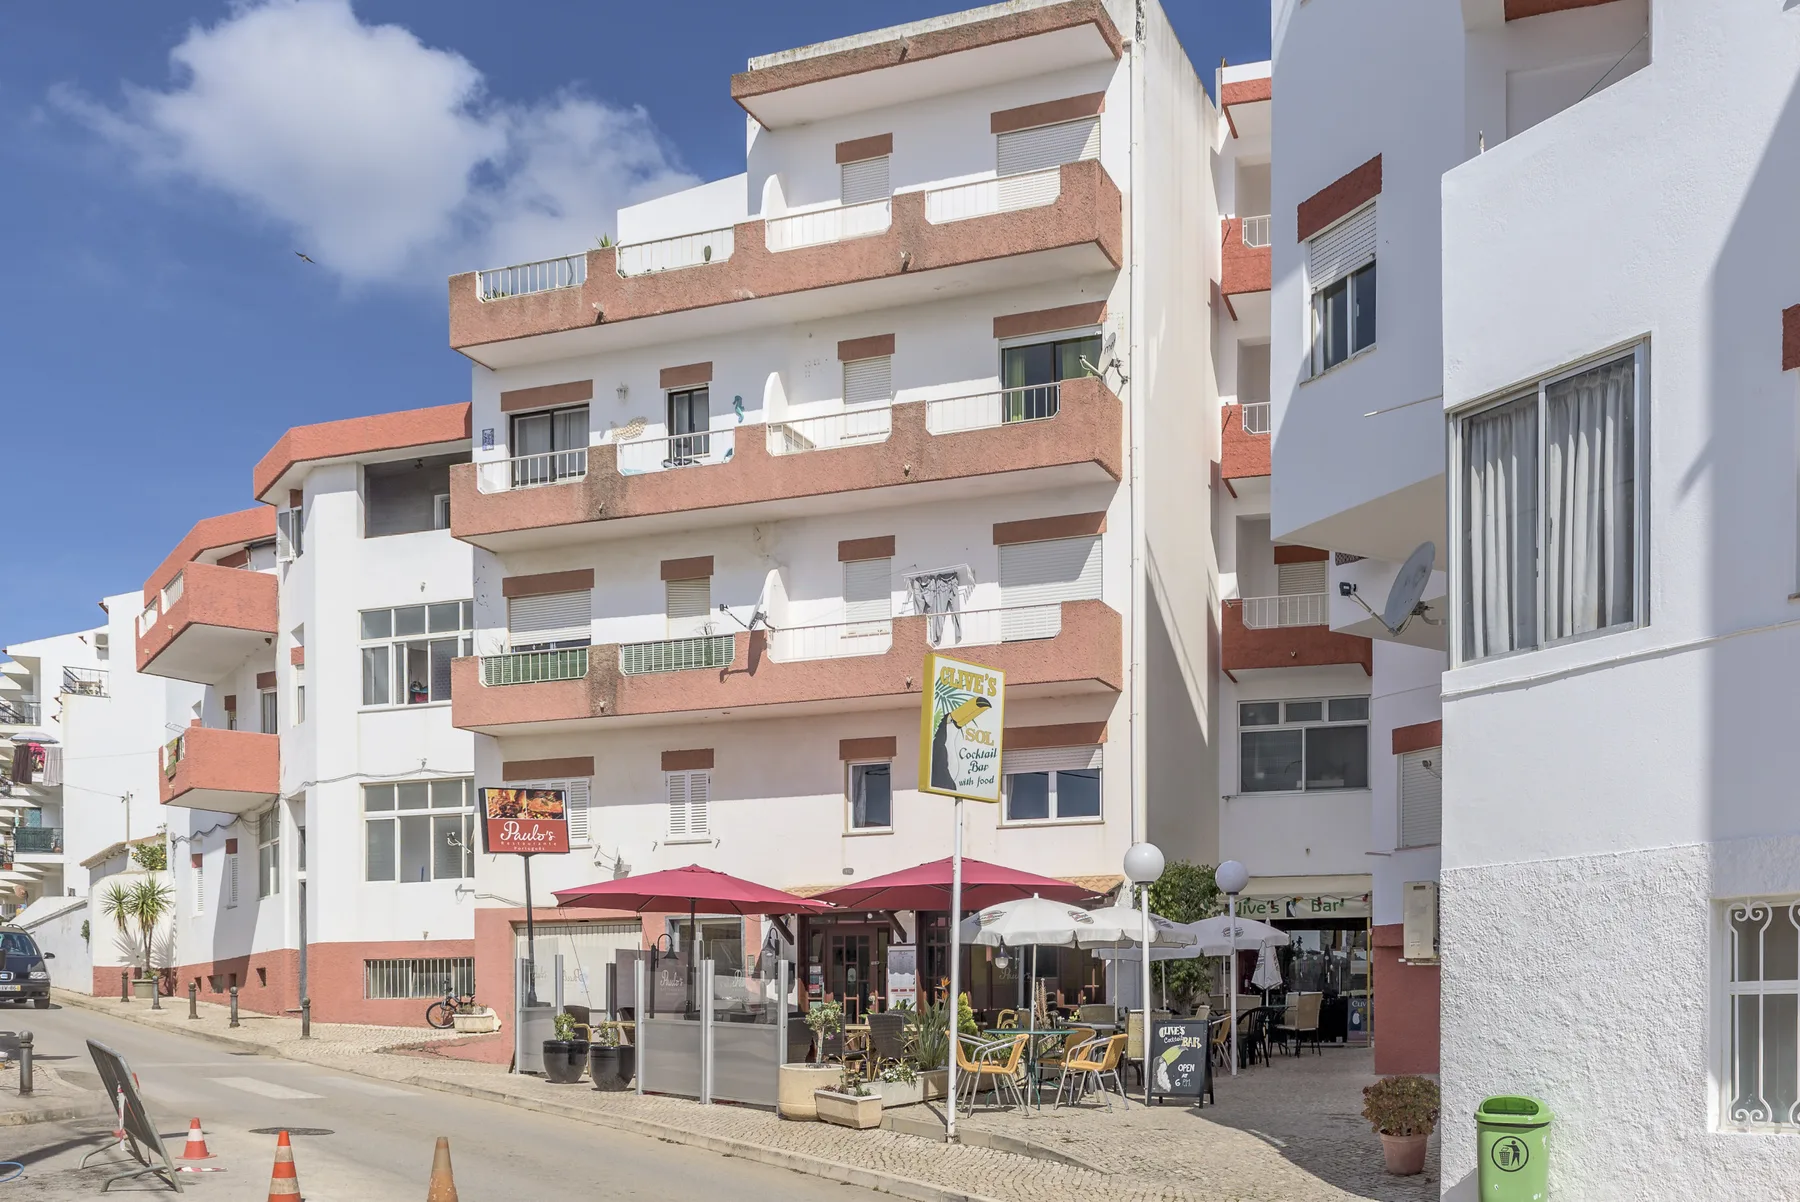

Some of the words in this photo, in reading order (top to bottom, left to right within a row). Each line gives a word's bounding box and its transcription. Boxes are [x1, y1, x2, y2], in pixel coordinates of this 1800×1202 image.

[940, 666, 997, 697] CLIVE'S
[965, 727, 995, 747] SOL
[958, 747, 998, 760] Cocktail
[968, 760, 989, 775] Bar
[958, 776, 974, 786] with
[976, 775, 995, 788] food
[500, 820, 556, 842] Paulo's
[1236, 900, 1280, 914] live's
[1311, 899, 1339, 913] Bar
[1159, 1025, 1186, 1038] CLIVE'S
[1181, 1036, 1202, 1049] BAR
[1177, 1063, 1195, 1072] OPEN
[1174, 1078, 1181, 1087] 6
